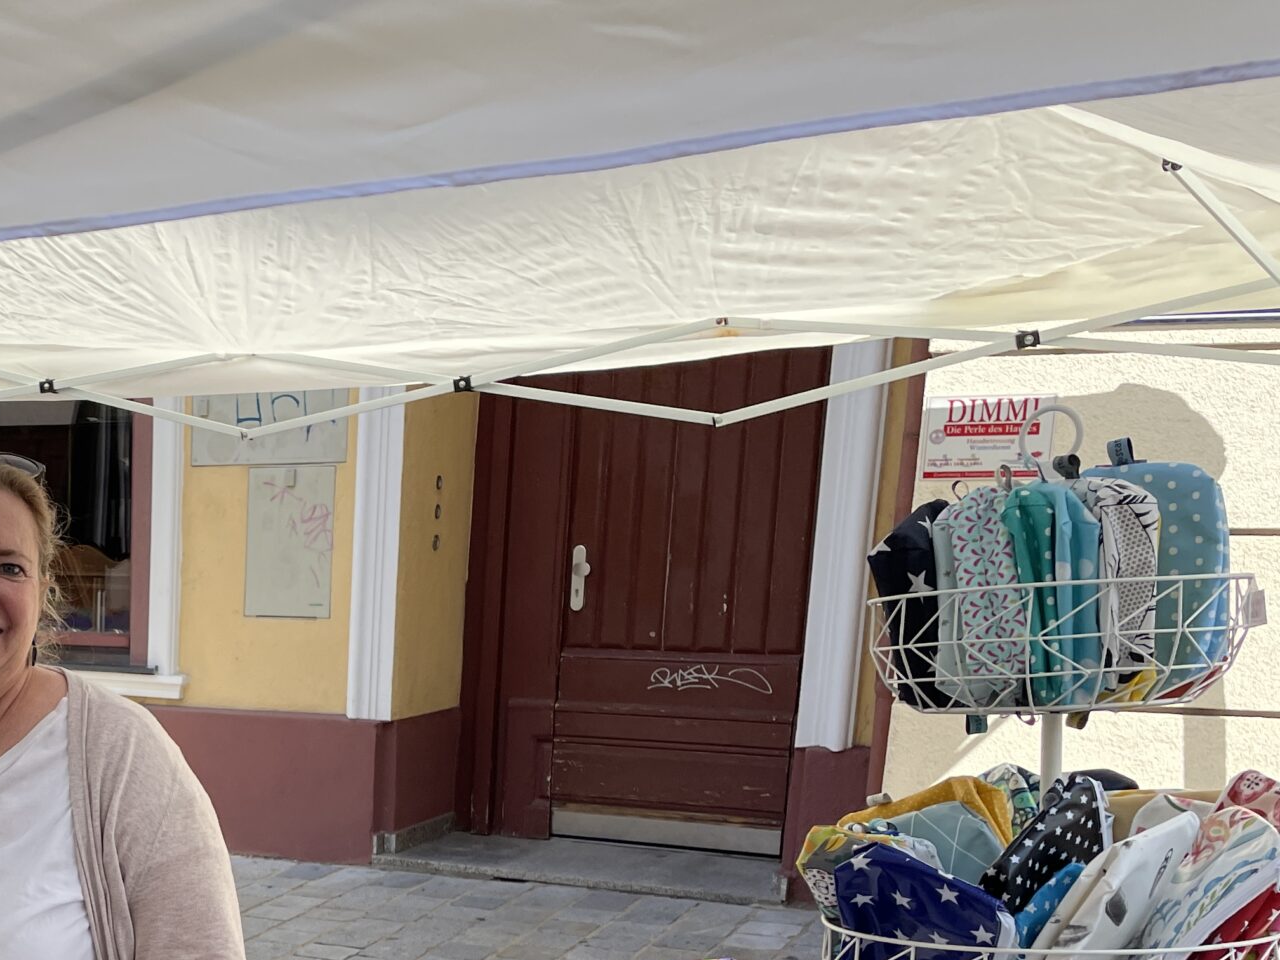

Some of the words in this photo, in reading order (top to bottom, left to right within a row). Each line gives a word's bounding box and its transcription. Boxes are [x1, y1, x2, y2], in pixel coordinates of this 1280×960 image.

[946, 424, 962, 435] Die
[964, 424, 986, 434] Perle
[988, 423, 1003, 433] des
